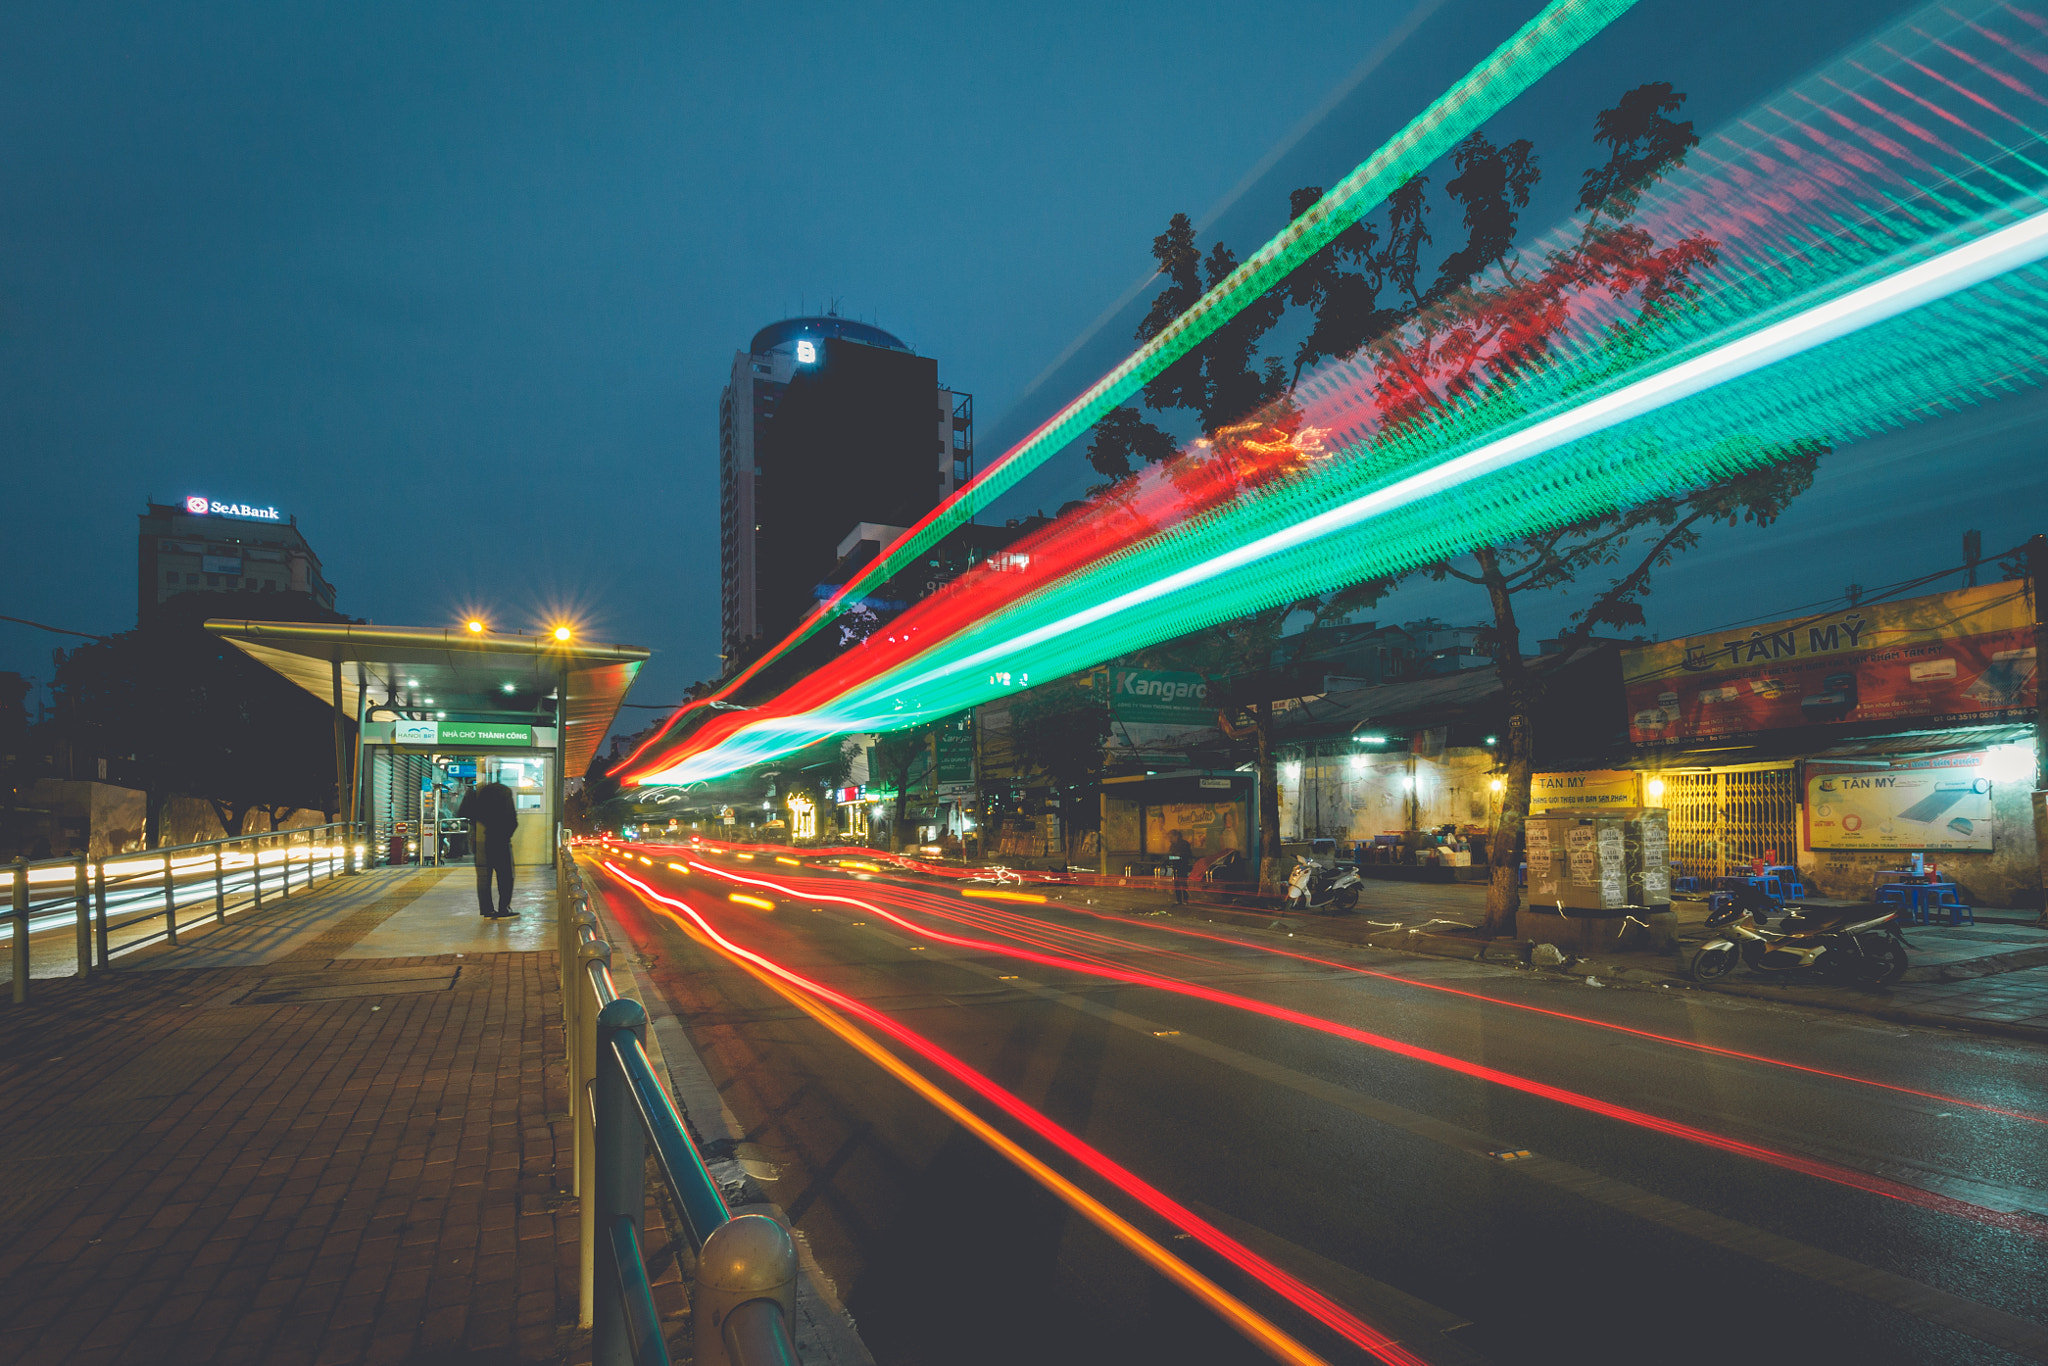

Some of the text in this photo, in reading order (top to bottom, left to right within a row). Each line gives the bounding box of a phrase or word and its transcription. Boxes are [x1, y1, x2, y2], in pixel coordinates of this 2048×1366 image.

[210, 501, 280, 519] SeABank
[1723, 613, 1867, 664] TÂN MỸ
[1116, 672, 1208, 702] Kangaro
[442, 730, 528, 740] NHÀ CHỜ THÀNH CÔNG
[1539, 773, 1586, 788] TÂN MỸ
[1842, 775, 1896, 789] TÂN MỸ
